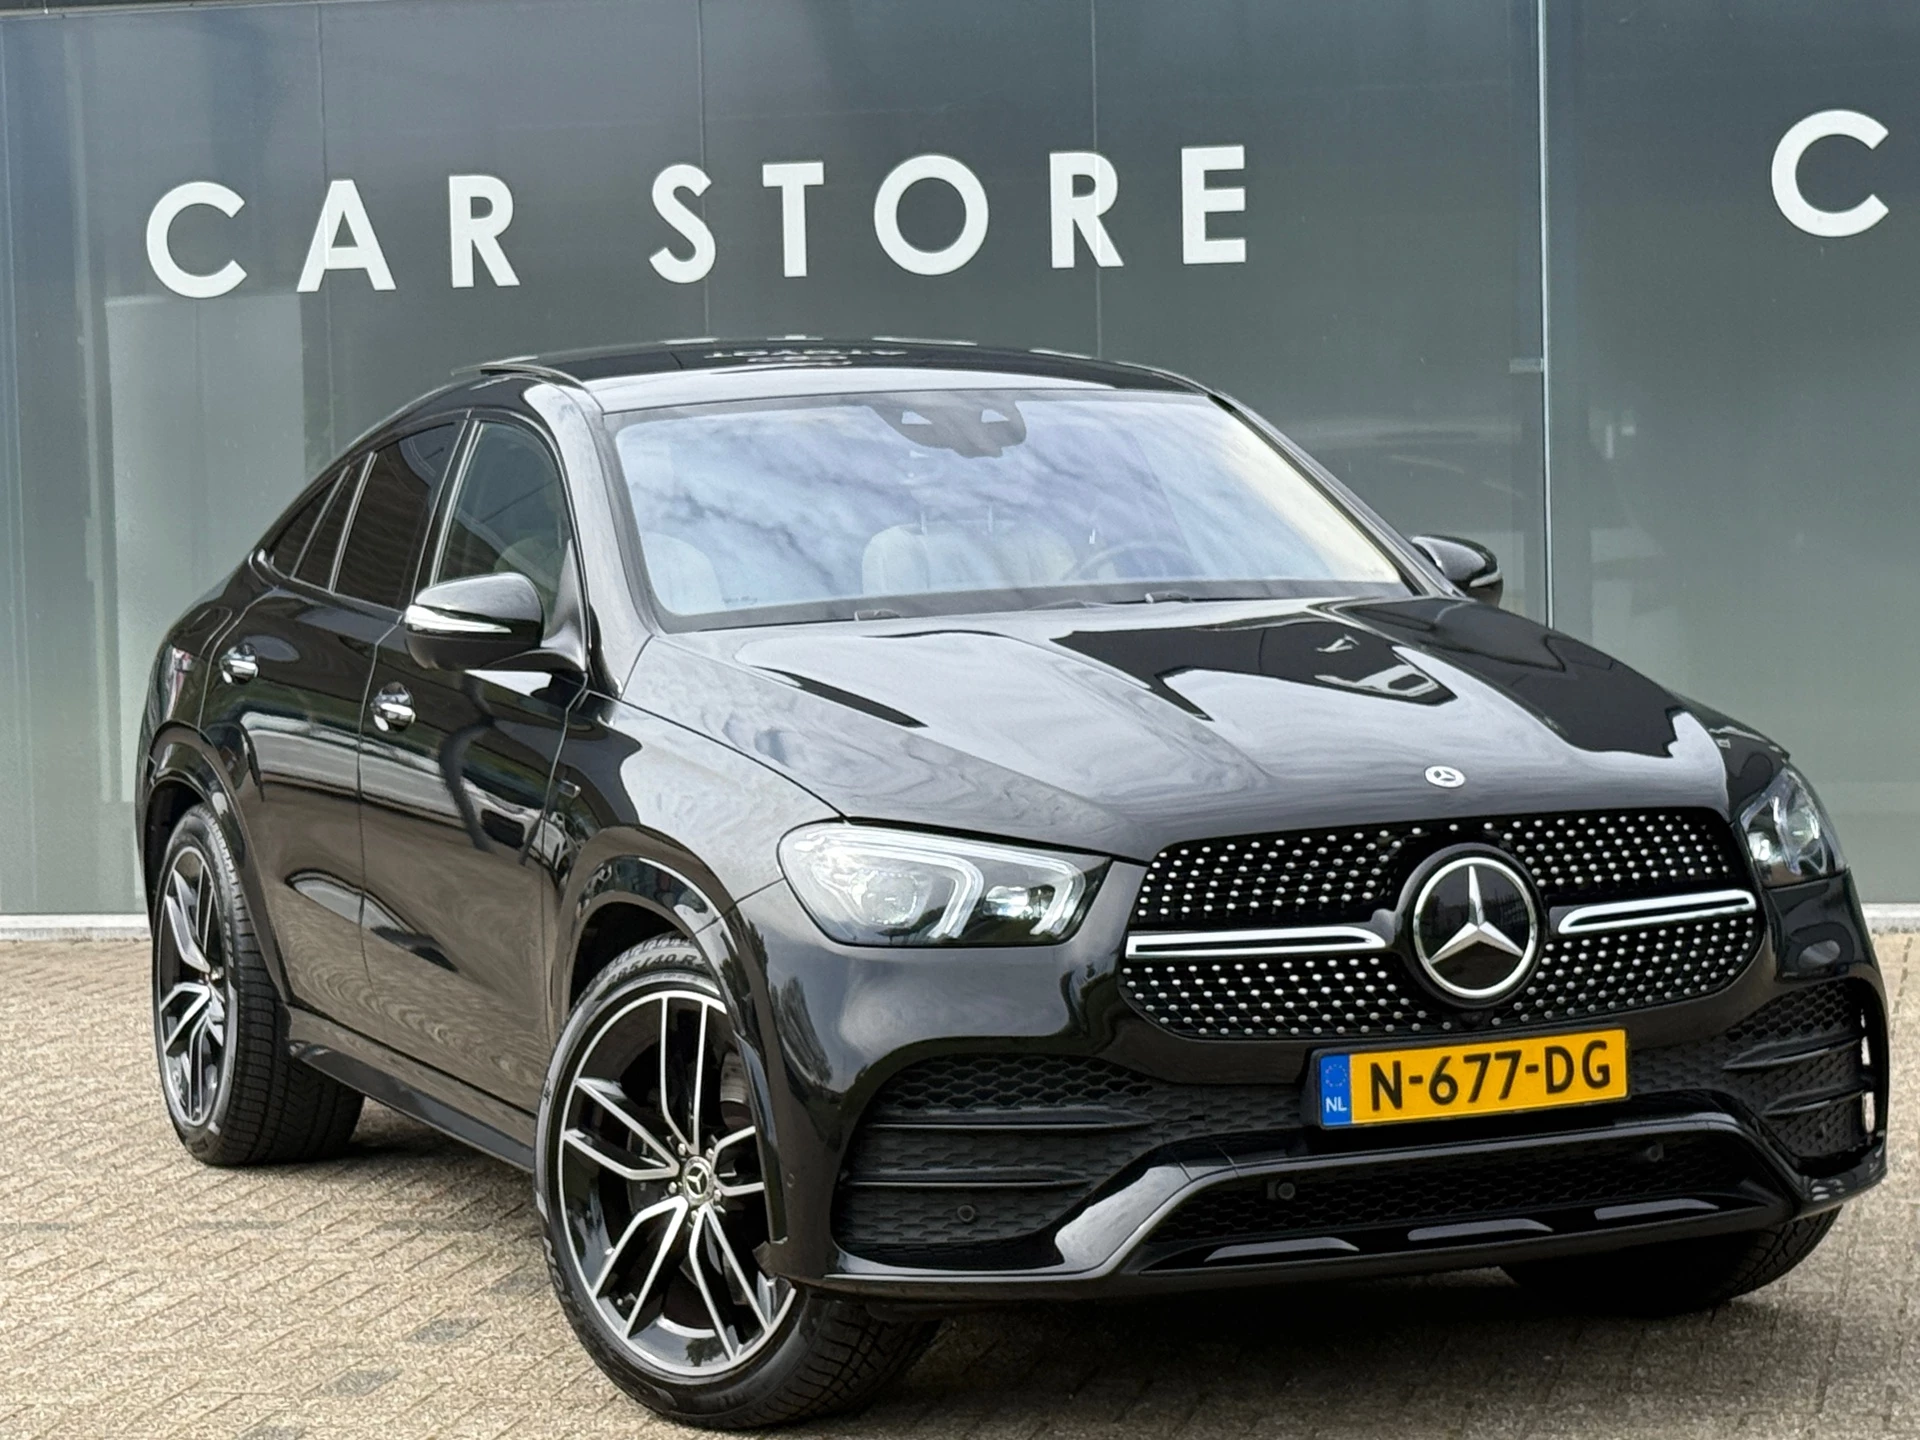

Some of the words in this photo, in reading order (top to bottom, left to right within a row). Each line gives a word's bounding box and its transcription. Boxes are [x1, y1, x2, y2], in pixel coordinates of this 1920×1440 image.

[146, 174, 520, 298] CAR
[649, 145, 1246, 283] STORE
[1771, 110, 1889, 237] C
[1325, 1096, 1347, 1113] NL
[1370, 1040, 1611, 1112] N-677-DG
